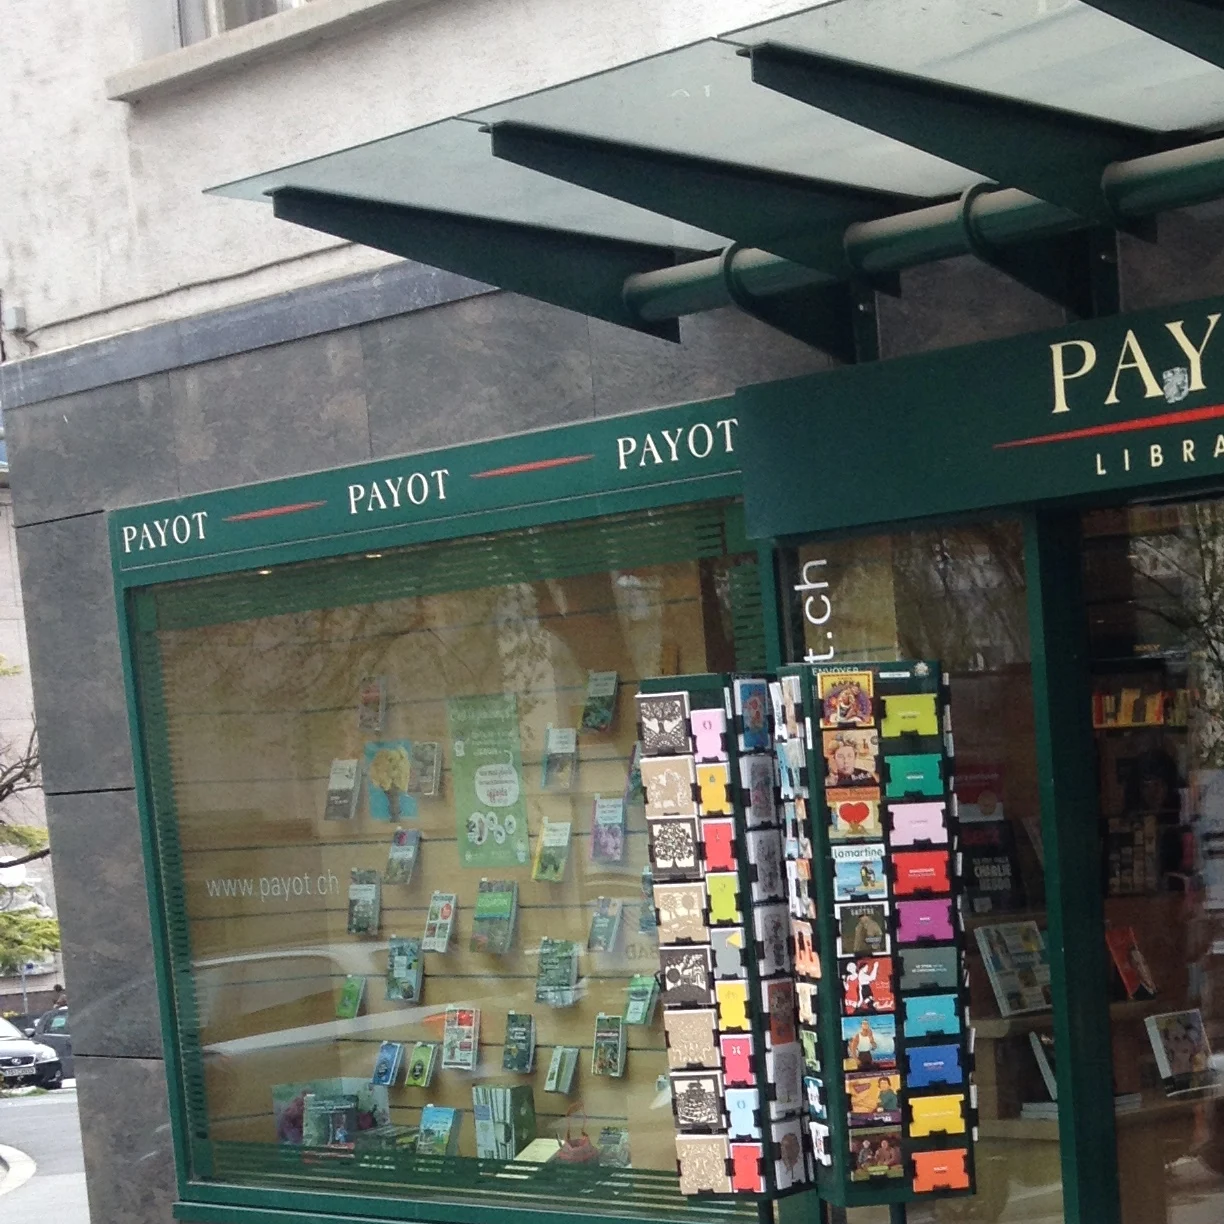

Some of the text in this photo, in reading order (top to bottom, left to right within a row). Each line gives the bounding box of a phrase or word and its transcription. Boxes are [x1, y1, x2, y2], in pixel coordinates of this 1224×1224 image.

[616, 418, 739, 470] PAYOT
[348, 469, 450, 514] PAYOT
[122, 511, 209, 553] PAYOT
[834, 846, 883, 858] lamartine
[205, 868, 340, 903] www.payot.ch
